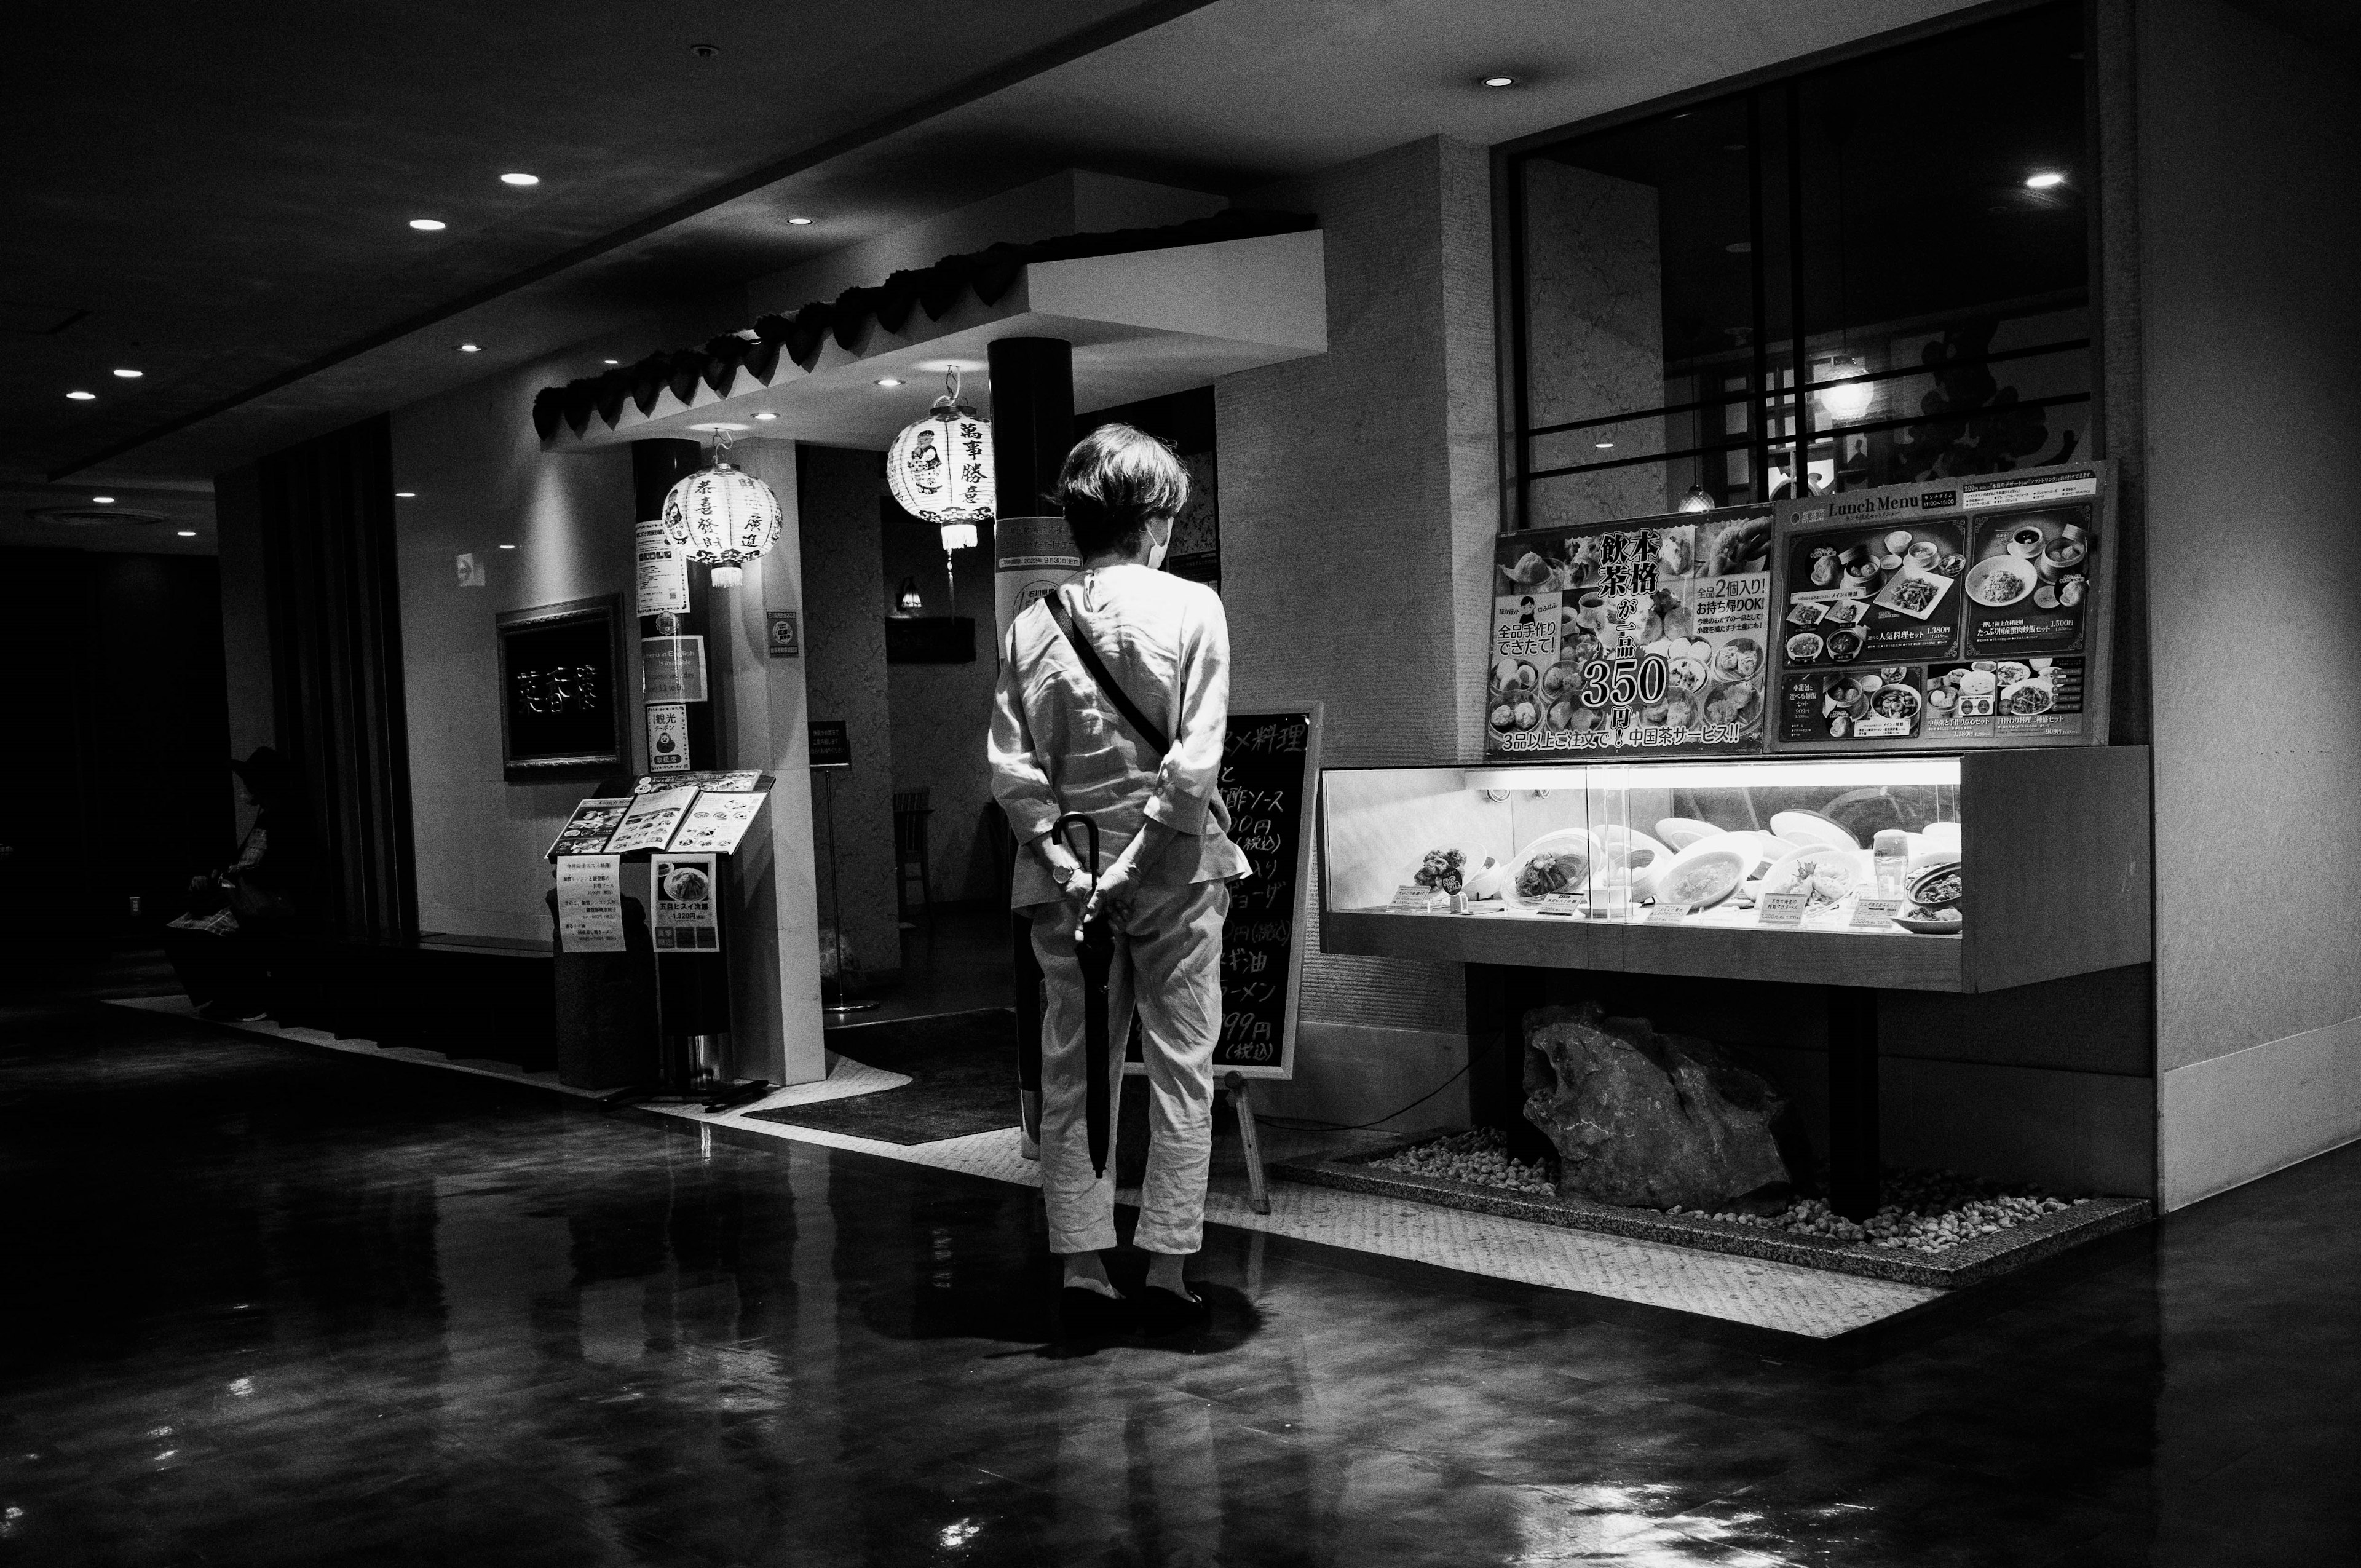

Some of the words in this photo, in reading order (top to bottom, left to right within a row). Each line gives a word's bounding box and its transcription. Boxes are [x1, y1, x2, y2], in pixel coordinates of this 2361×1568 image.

[960, 422, 987, 504] 萬事勝意
[1829, 498, 1875, 517] Lunch
[1878, 495, 1920, 511] Menu
[1598, 531, 1629, 598] 飲茶
[1628, 529, 1661, 595] 本格
[1697, 578, 1765, 599] 全品2個入り!
[1697, 597, 1764, 615] お持ち帰りOK!
[1498, 622, 1556, 638] 全品手作り
[1927, 626, 1950, 635] 1,380円
[1498, 637, 1554, 655] できたて!
[656, 713, 676, 724] 観光
[1503, 731, 1609, 751] 3品以上ご注文で
[1629, 723, 1740, 746] 中国茶サービス!!
[1221, 766, 1236, 783] と
[1222, 1012, 1271, 1041] 99円
[1225, 1041, 1273, 1063] (税込)
